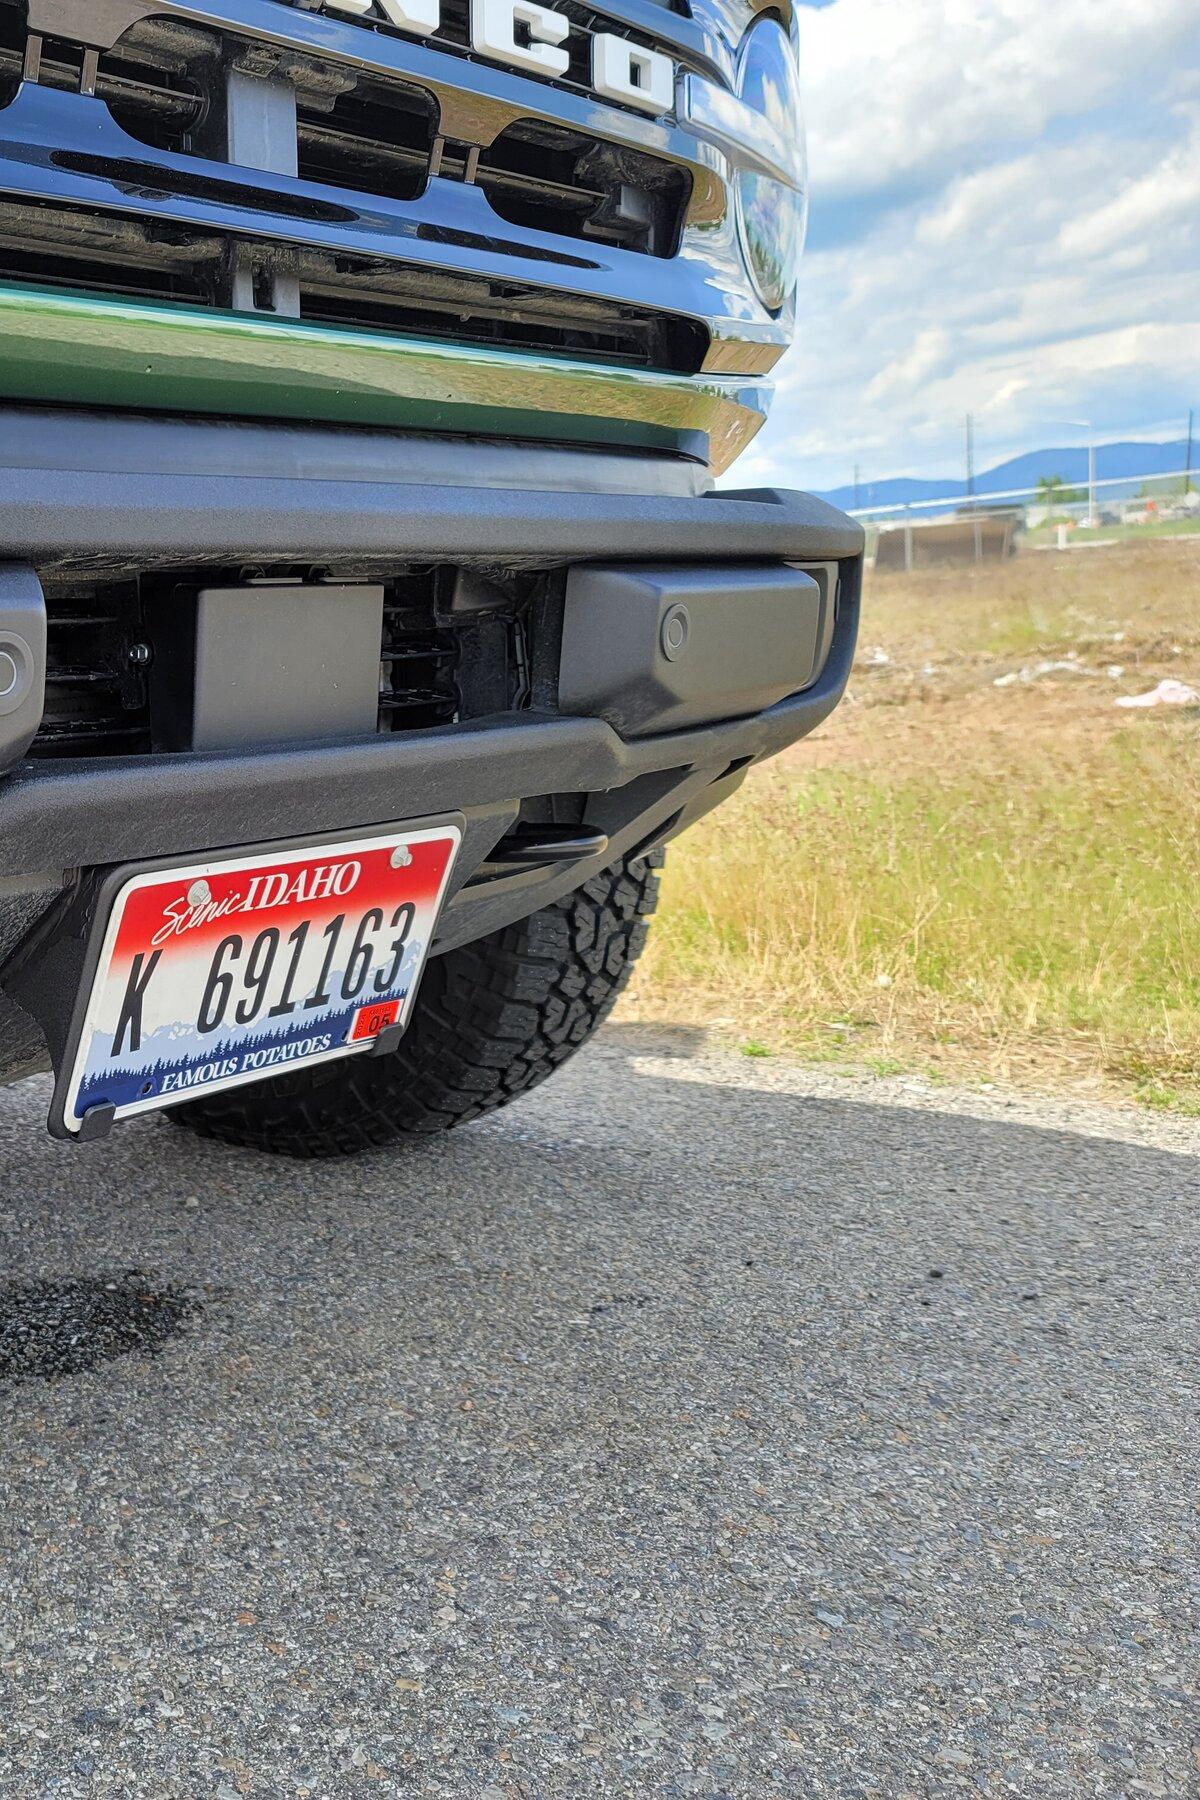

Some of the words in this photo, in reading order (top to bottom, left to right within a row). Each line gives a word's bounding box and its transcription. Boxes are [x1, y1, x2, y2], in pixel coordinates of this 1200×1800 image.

[151, 890, 241, 946] Scenic
[239, 861, 361, 912] IDAHO
[111, 949, 163, 1058] K
[196, 901, 417, 1034] 691163
[368, 1013, 391, 1033] 05
[159, 1056, 239, 1094] FAMOUS
[241, 1033, 333, 1072] POTATOES
